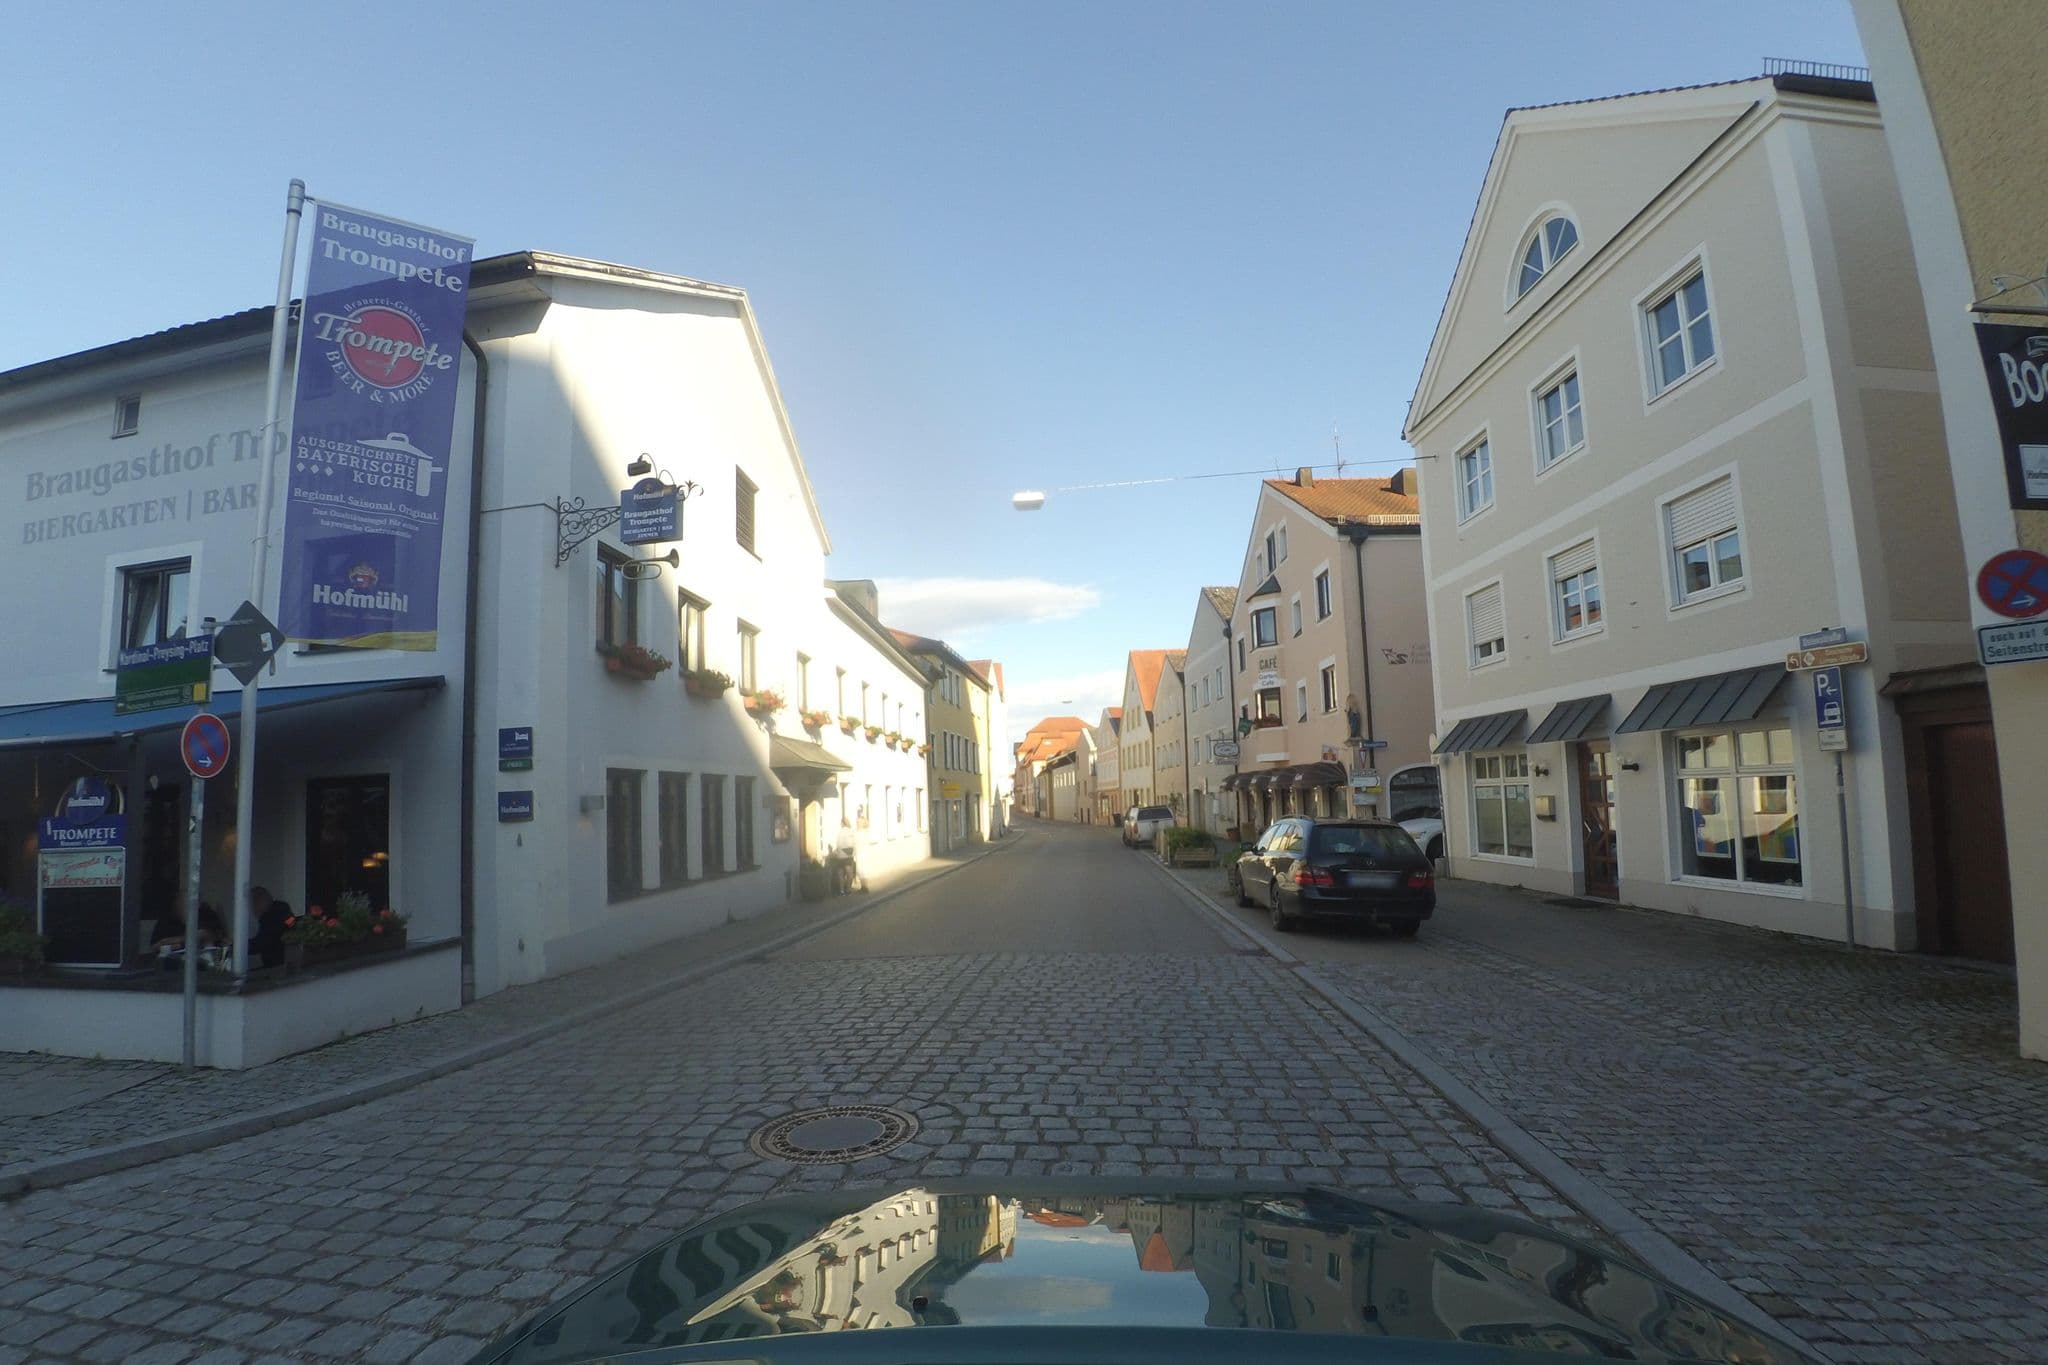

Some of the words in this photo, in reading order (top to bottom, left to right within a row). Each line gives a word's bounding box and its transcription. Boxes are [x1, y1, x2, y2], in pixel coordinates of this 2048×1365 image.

[322, 213, 467, 264] Braugasthof
[321, 238, 463, 293] Trompete
[314, 313, 453, 375] Trompete
[326, 351, 365, 394] BEER
[369, 389, 384, 403] &
[389, 373, 434, 403] MORE
[25, 433, 221, 501] Braugasthof
[297, 446, 416, 479] BAYERISCHE
[298, 435, 416, 467] AUSGEZEICHNETE
[22, 496, 177, 545] BIERGARTEN
[202, 483, 257, 515] BAR
[294, 487, 346, 504] Regional.
[347, 495, 396, 513] Saisonal.
[398, 503, 439, 521] Original.
[624, 507, 673, 519] Braugasthof
[630, 516, 668, 526] Trompete
[312, 584, 408, 613] Hofmühl
[1817, 674, 1828, 697] P
[52, 827, 117, 841] TROMPETE
